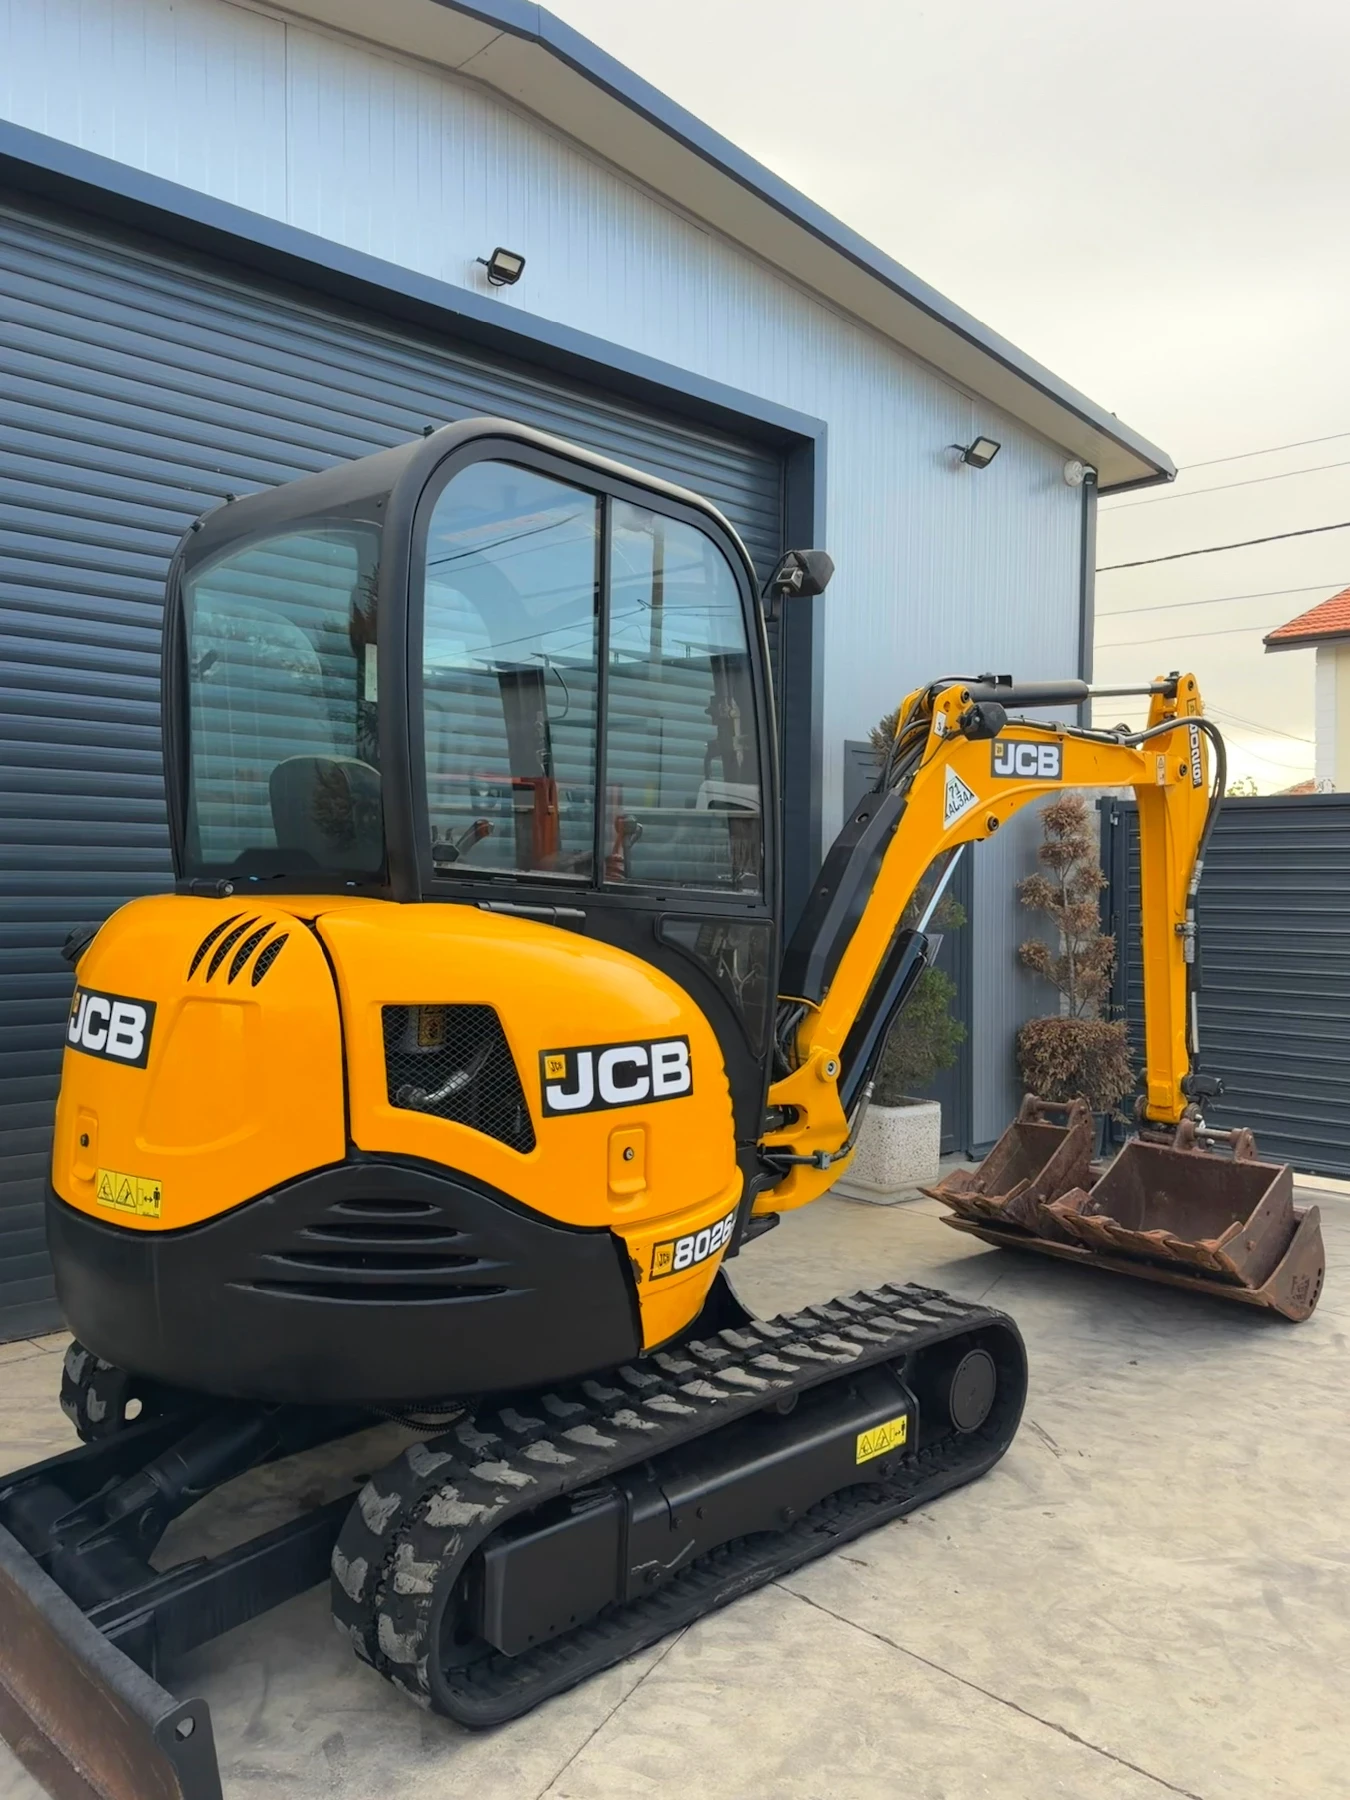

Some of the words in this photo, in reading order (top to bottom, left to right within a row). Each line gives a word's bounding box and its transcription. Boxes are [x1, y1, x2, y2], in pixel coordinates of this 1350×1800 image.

[994, 743, 1060, 777] JCB
[68, 993, 147, 1060] JCB
[546, 1040, 691, 1110] JCB
